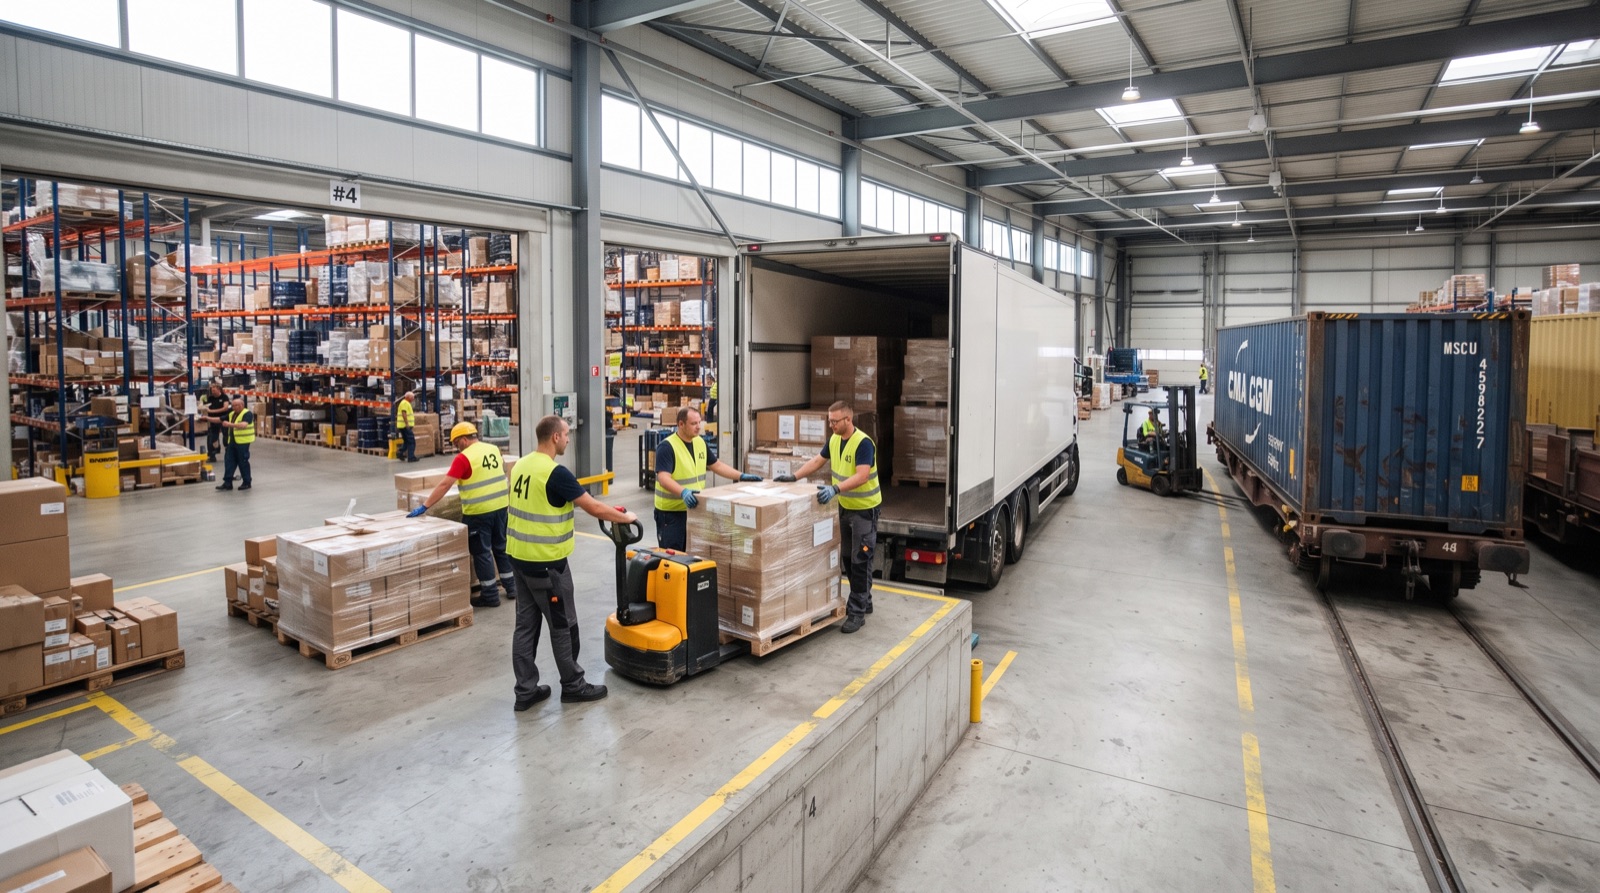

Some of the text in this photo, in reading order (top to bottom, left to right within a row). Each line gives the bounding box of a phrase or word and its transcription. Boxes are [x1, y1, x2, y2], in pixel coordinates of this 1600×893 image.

[333, 186, 357, 203] #4
[1443, 342, 1477, 355] MSCU
[1228, 370, 1273, 416] CMA CGM
[1476, 358, 1487, 449] 4598227
[482, 454, 499, 470] 43
[513, 474, 531, 500] 41
[809, 795, 816, 817] 4
